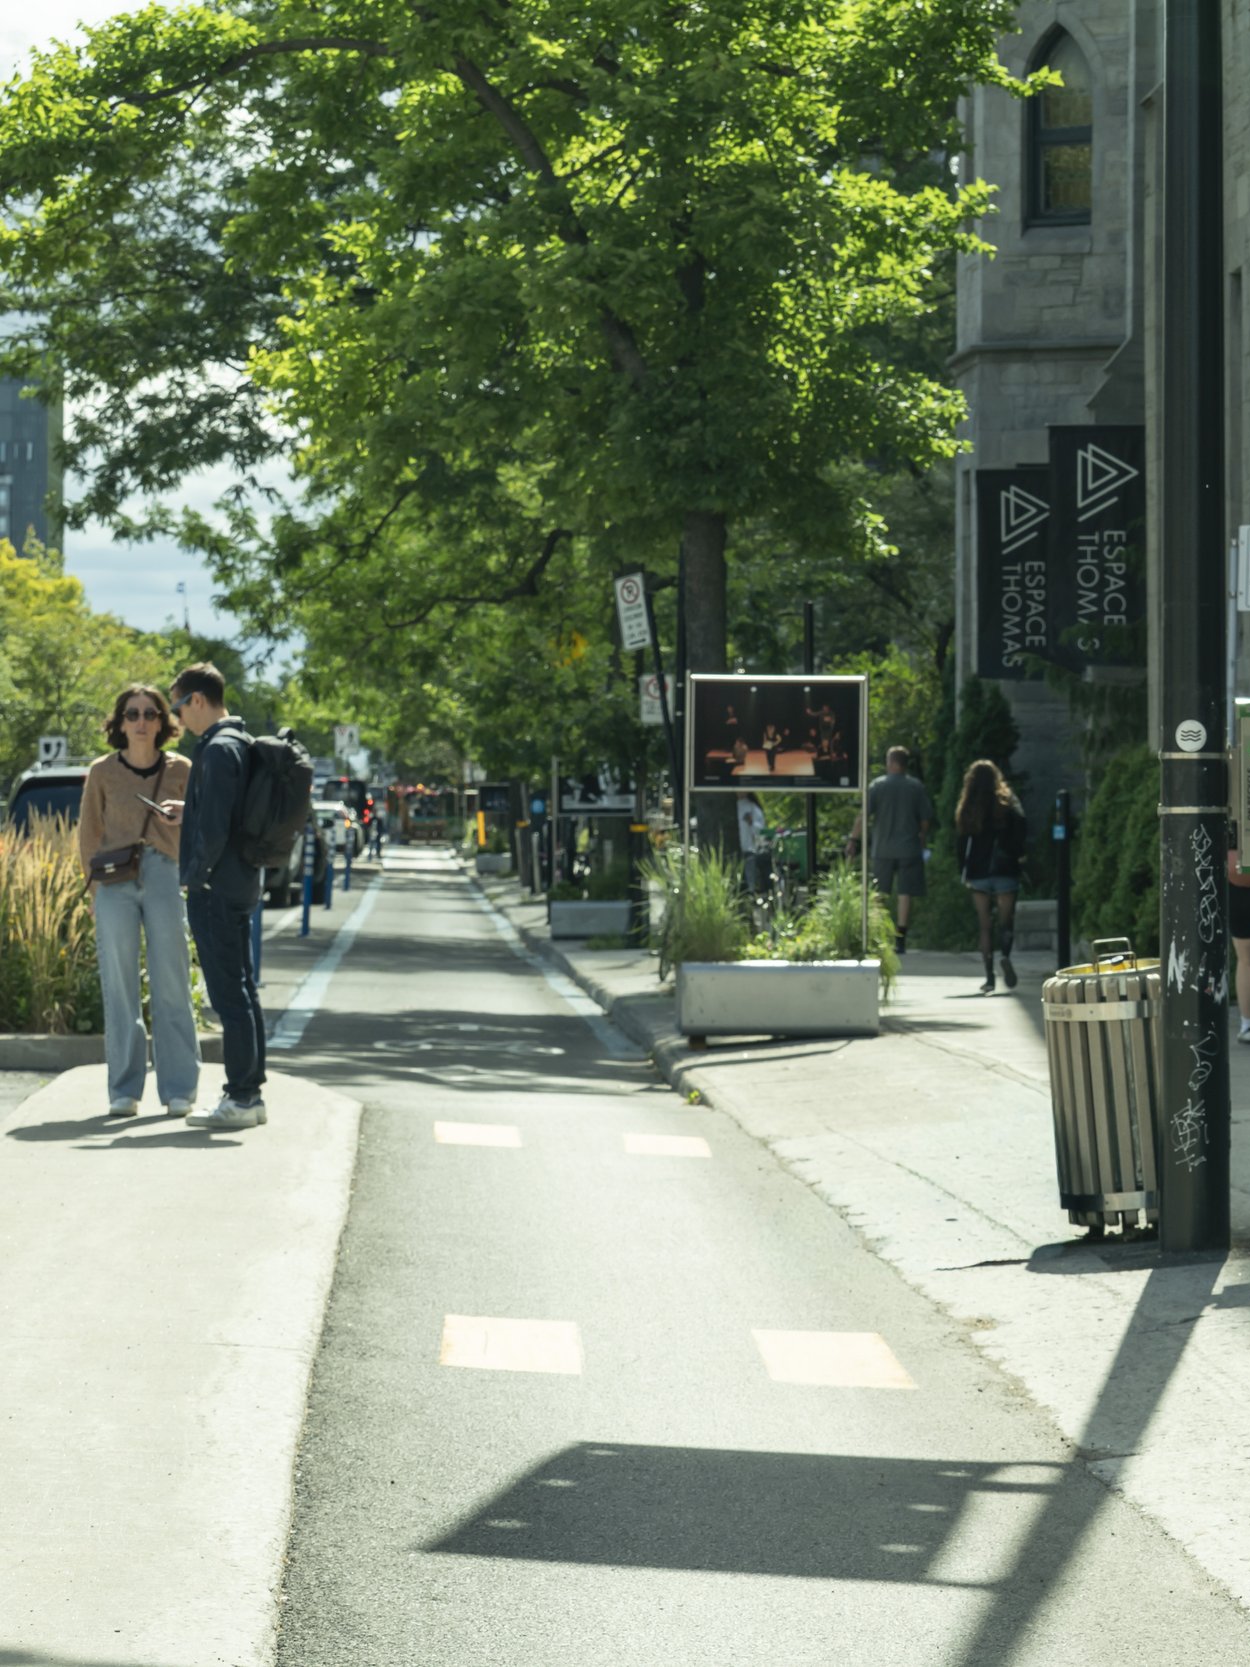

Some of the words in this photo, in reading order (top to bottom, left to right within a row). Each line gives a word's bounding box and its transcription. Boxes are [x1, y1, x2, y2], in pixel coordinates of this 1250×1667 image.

[1001, 562, 1024, 669] THOMAS
[1024, 560, 1047, 648] ESPACE
[1077, 530, 1100, 652] THOMS
[1103, 529, 1127, 627] ESPACE
